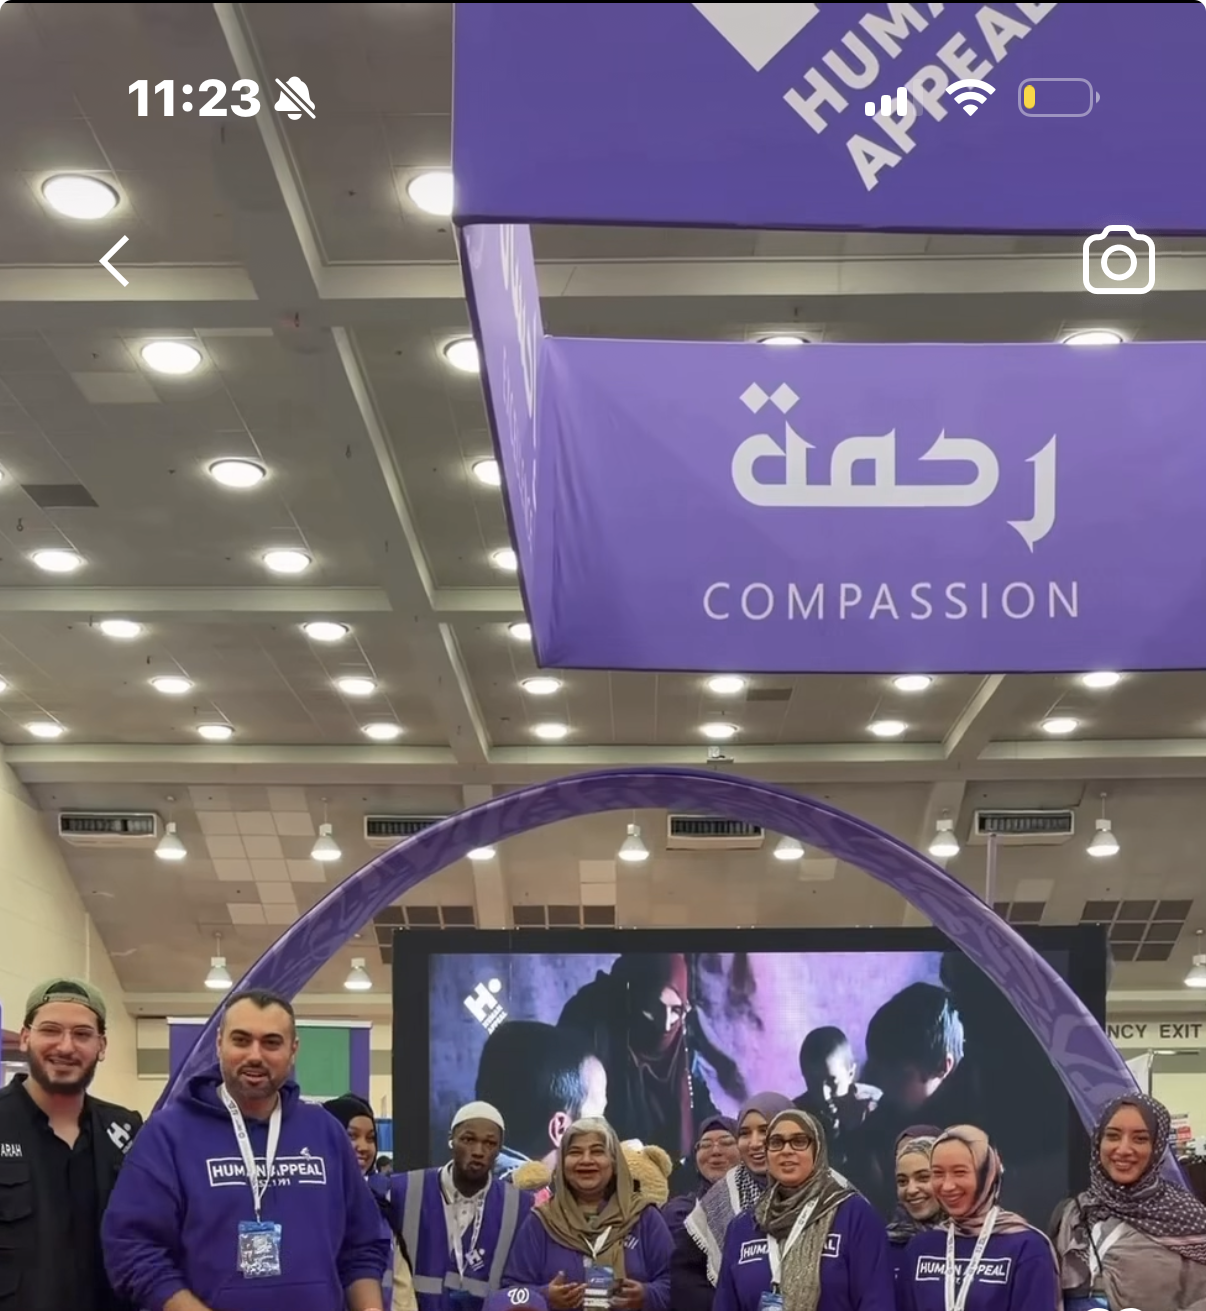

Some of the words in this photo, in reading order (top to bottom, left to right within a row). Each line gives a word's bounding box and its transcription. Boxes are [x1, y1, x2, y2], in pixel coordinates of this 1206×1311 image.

[783, 3, 945, 134] HUM
[731, 382, 1057, 552] رحمة
[703, 581, 1079, 620] COMPASSION
[1160, 1024, 1202, 1039] EXIT
[212, 1163, 267, 1178] HUMN
[743, 1245, 769, 1258] HUM
